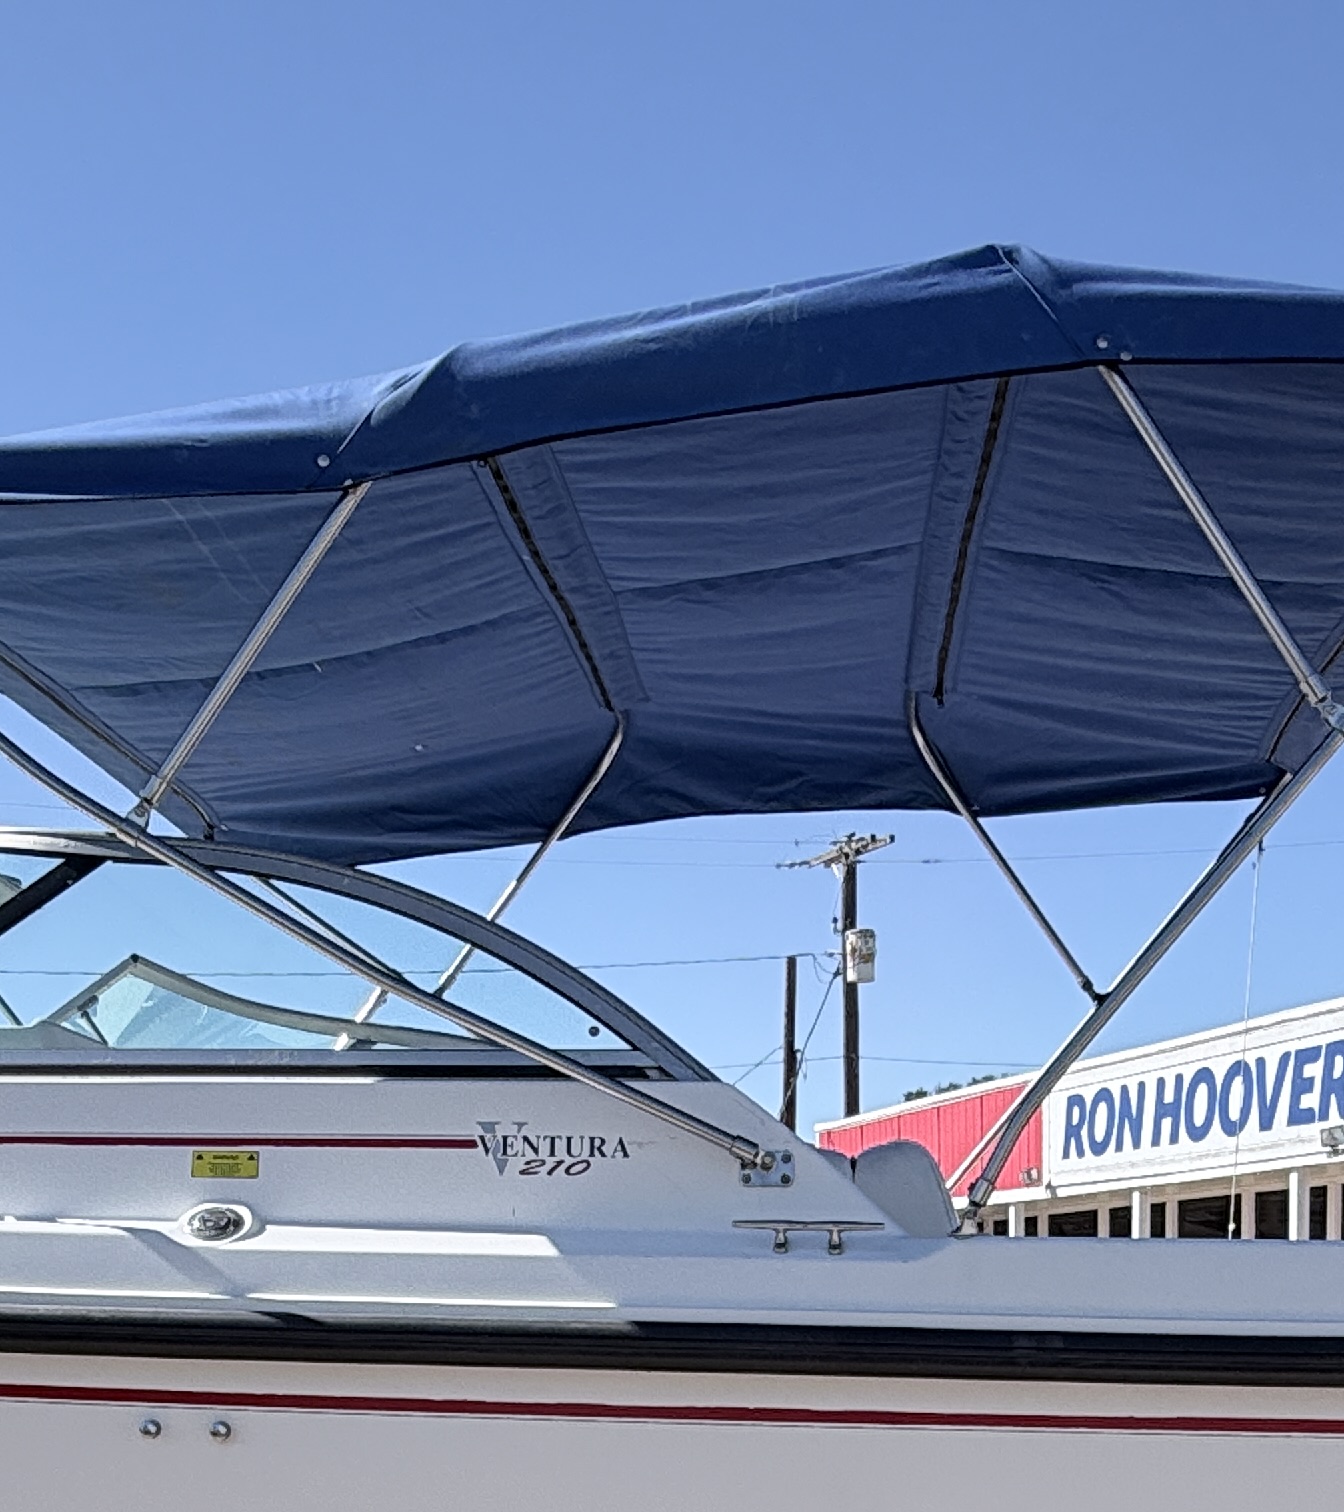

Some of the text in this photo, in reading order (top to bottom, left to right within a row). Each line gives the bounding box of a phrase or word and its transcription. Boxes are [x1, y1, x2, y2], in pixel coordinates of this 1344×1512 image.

[1062, 1080, 1145, 1159] RON
[478, 1135, 630, 1158] VENTURA
[519, 1159, 591, 1176] 210
